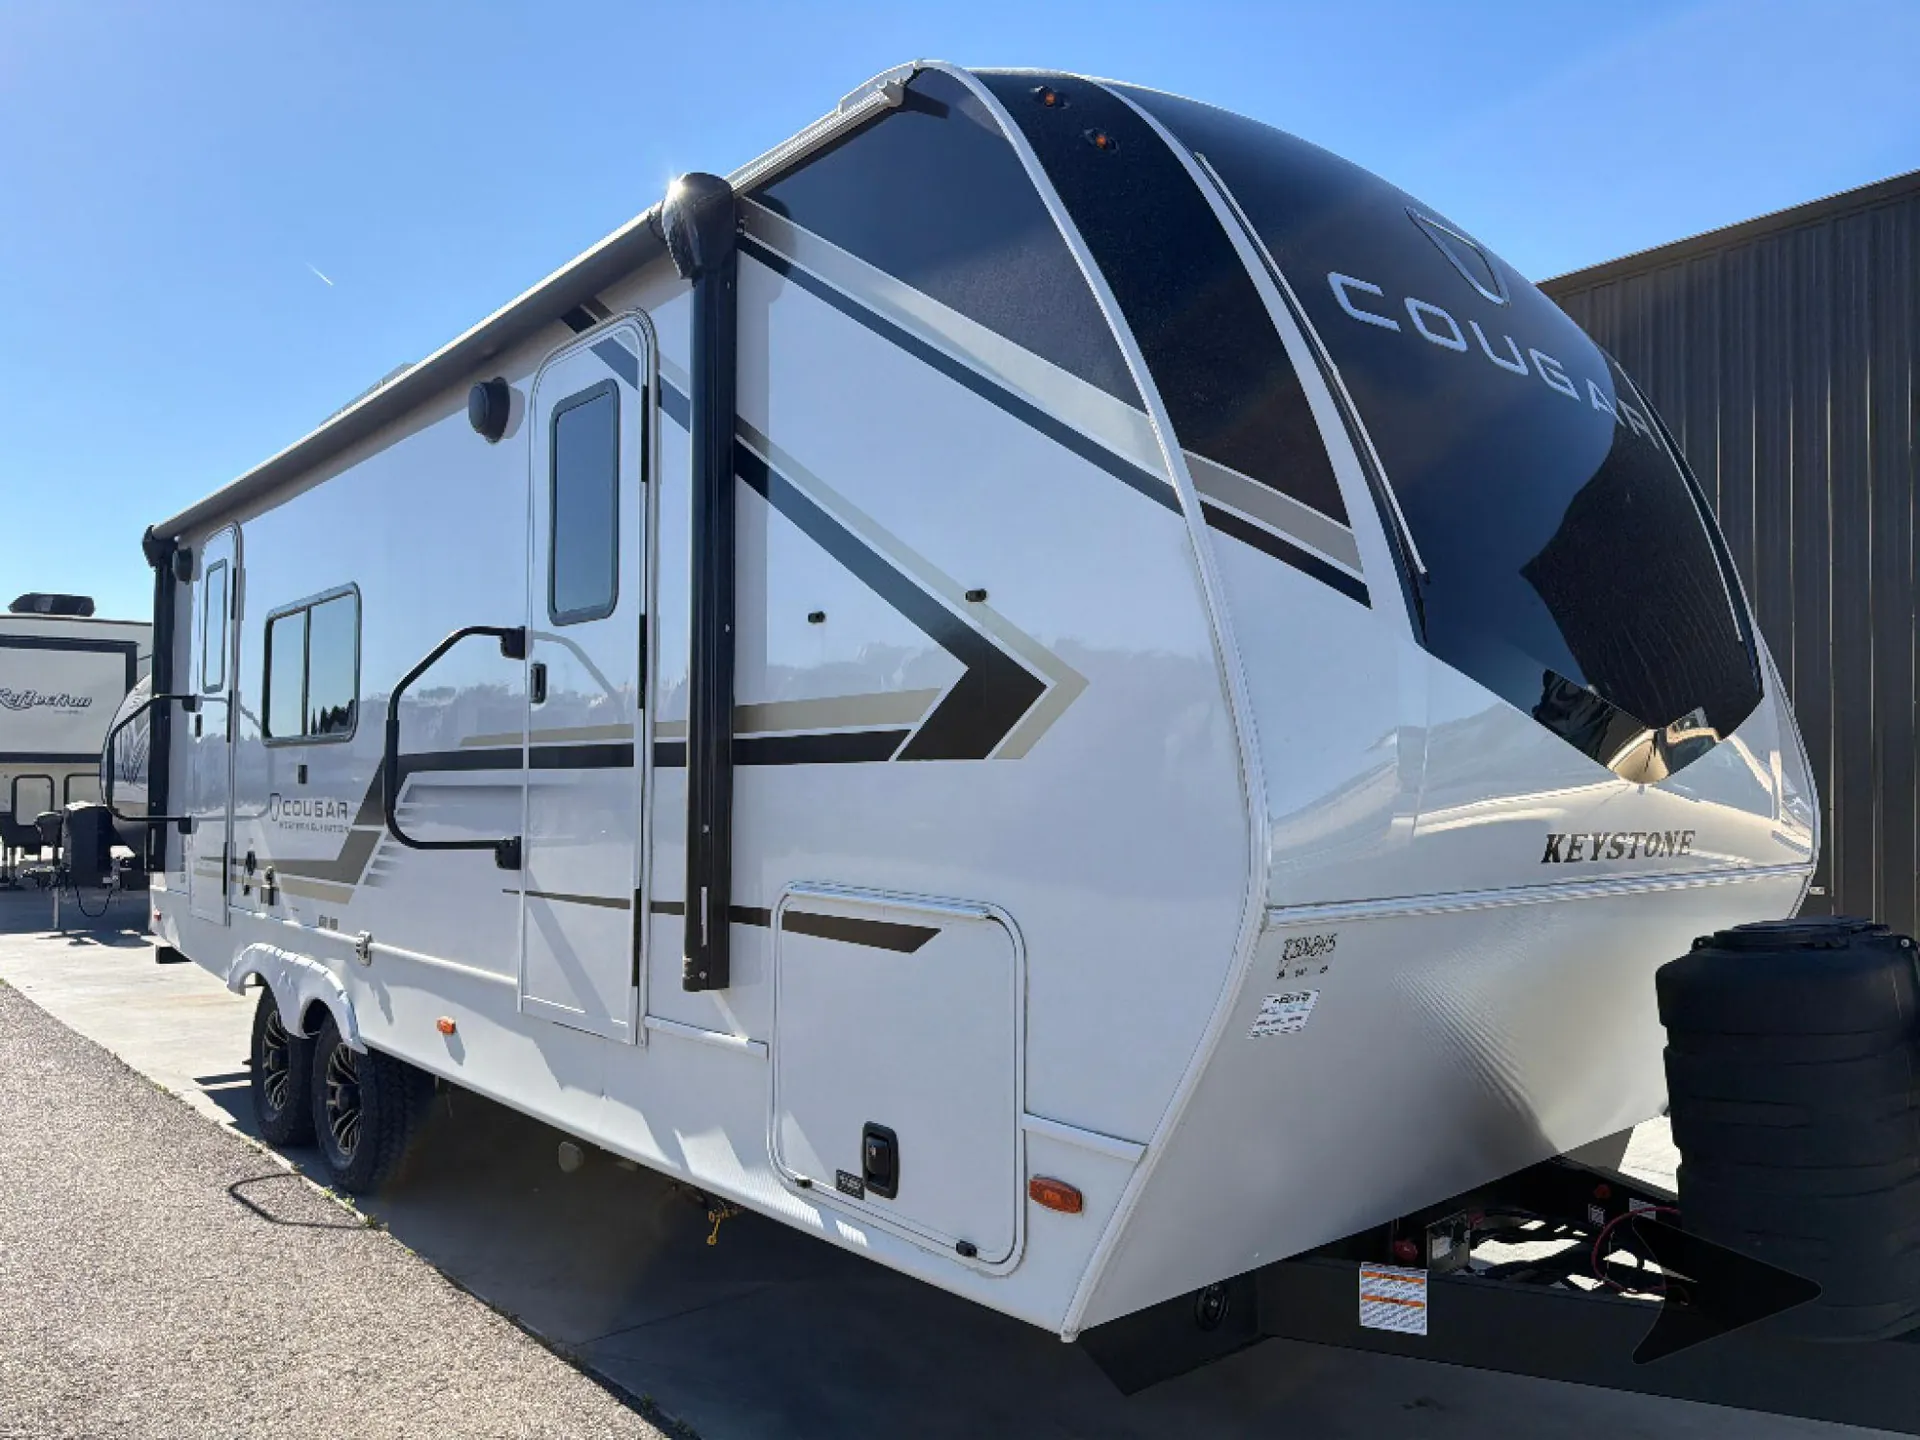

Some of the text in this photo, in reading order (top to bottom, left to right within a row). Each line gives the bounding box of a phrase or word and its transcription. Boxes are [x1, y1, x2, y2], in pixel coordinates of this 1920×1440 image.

[1326, 271, 1661, 450] COUGAR
[283, 800, 348, 820] COUGAR
[1541, 830, 1696, 864] KEYSTONE
